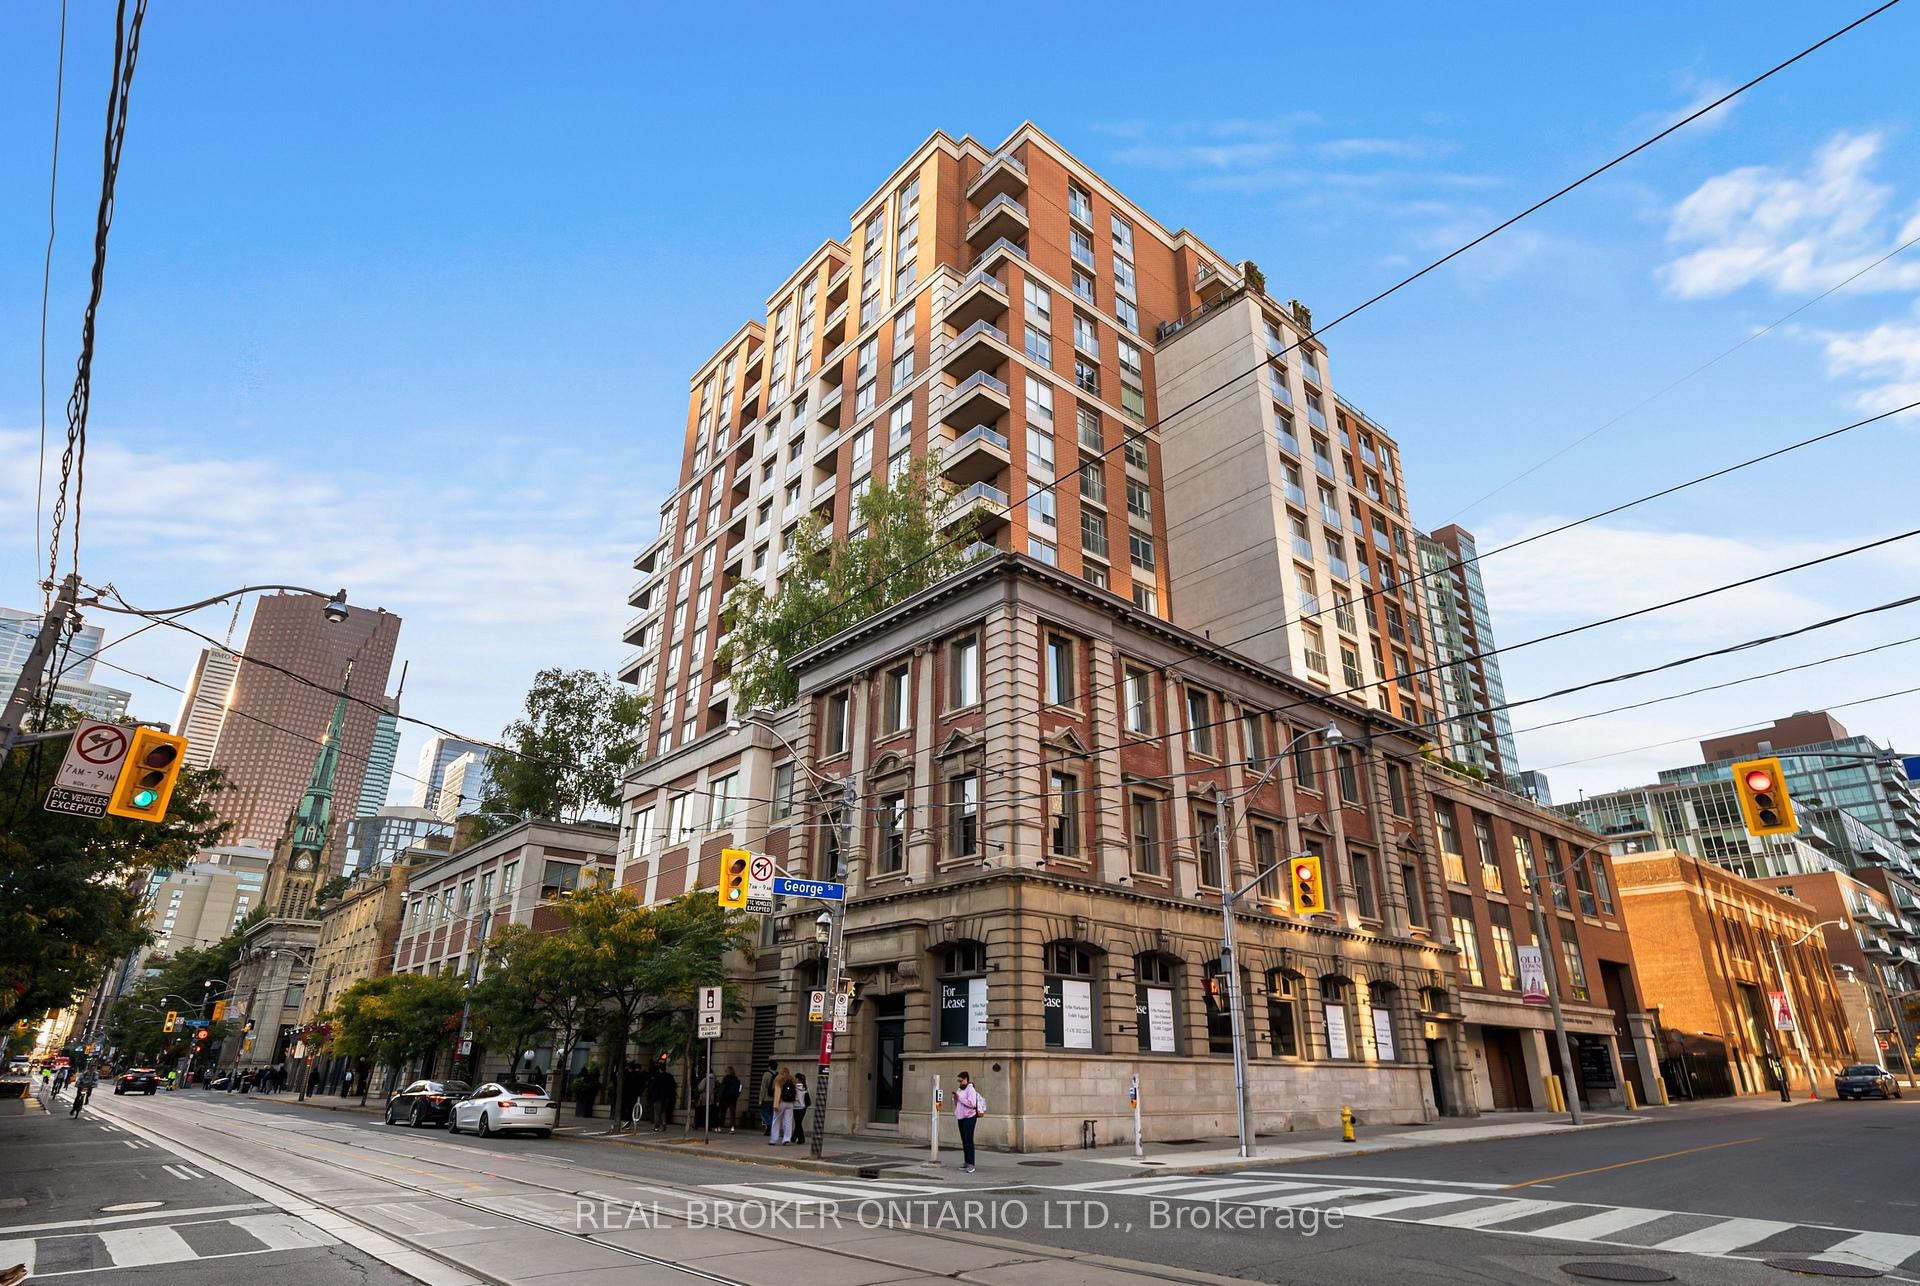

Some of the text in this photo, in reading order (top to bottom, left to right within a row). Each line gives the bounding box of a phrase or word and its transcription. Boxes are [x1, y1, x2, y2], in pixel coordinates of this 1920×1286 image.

[71, 793, 108, 806] VEHICLES
[50, 799, 102, 815] EXCEPTED
[784, 880, 824, 897] George
[747, 905, 771, 913] EXCEPTED
[1520, 955, 1541, 964] OLD
[942, 985, 956, 997] For
[942, 997, 966, 1009] Lease
[1042, 999, 1061, 1008] ease
